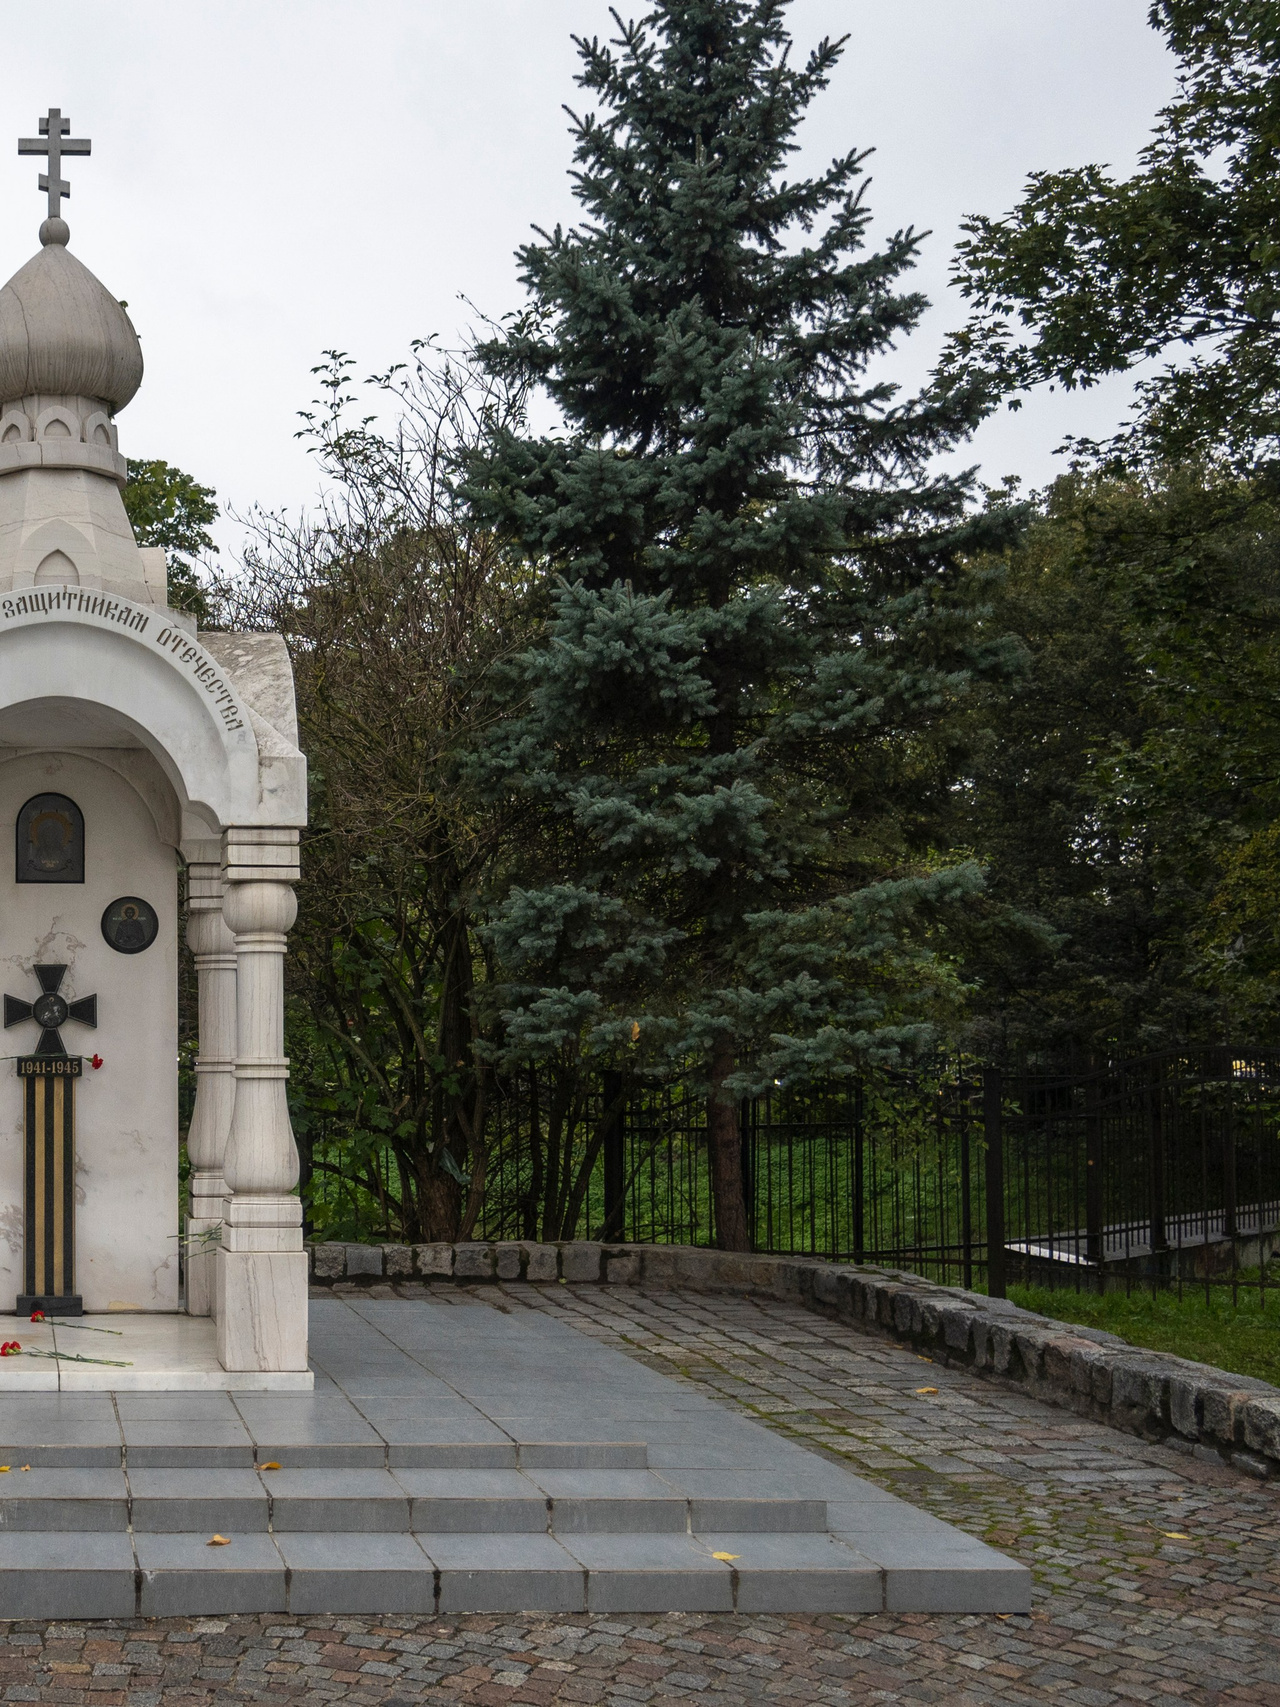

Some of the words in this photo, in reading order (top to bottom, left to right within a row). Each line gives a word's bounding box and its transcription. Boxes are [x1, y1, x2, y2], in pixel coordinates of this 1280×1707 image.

[2, 591, 150, 634] ЗАЩИТНИКАМ
[156, 628, 244, 732] ОТЕЧЕСТВА
[20, 1061, 80, 1074] 1941-1945
